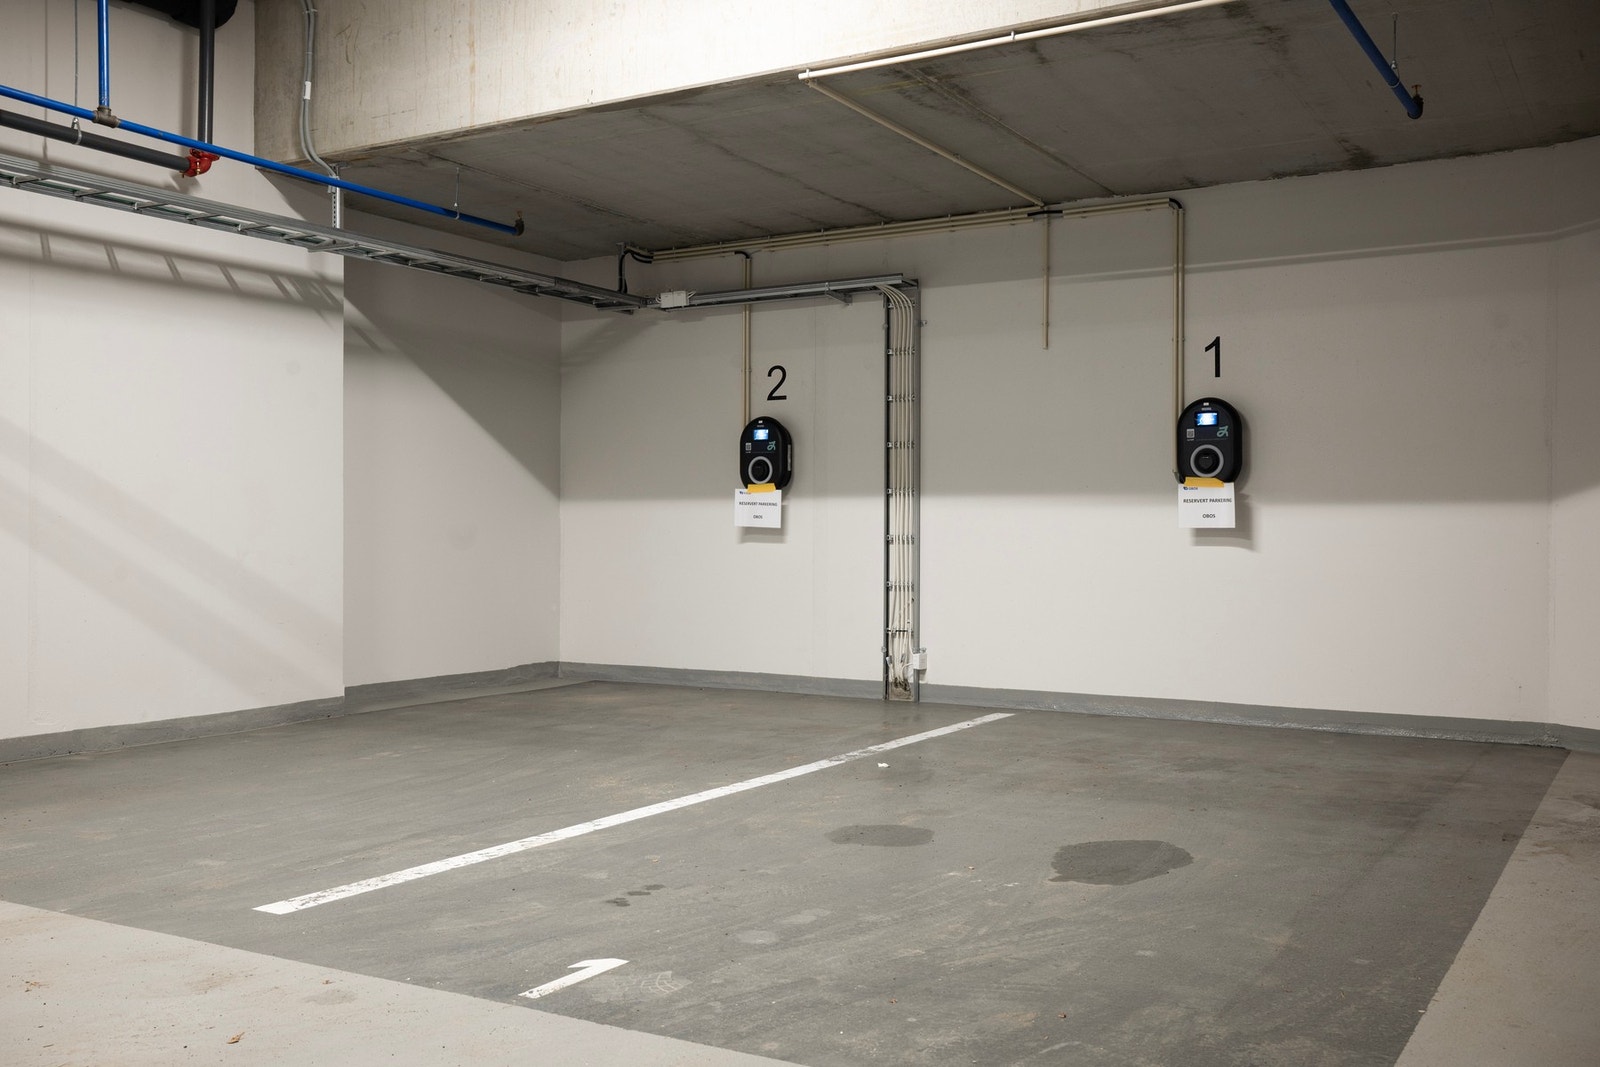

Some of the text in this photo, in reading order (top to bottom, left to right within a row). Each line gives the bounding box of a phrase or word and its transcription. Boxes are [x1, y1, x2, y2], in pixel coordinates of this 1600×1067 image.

[1204, 335, 1221, 378] 1
[766, 364, 788, 401] 2
[517, 958, 630, 999] 1
